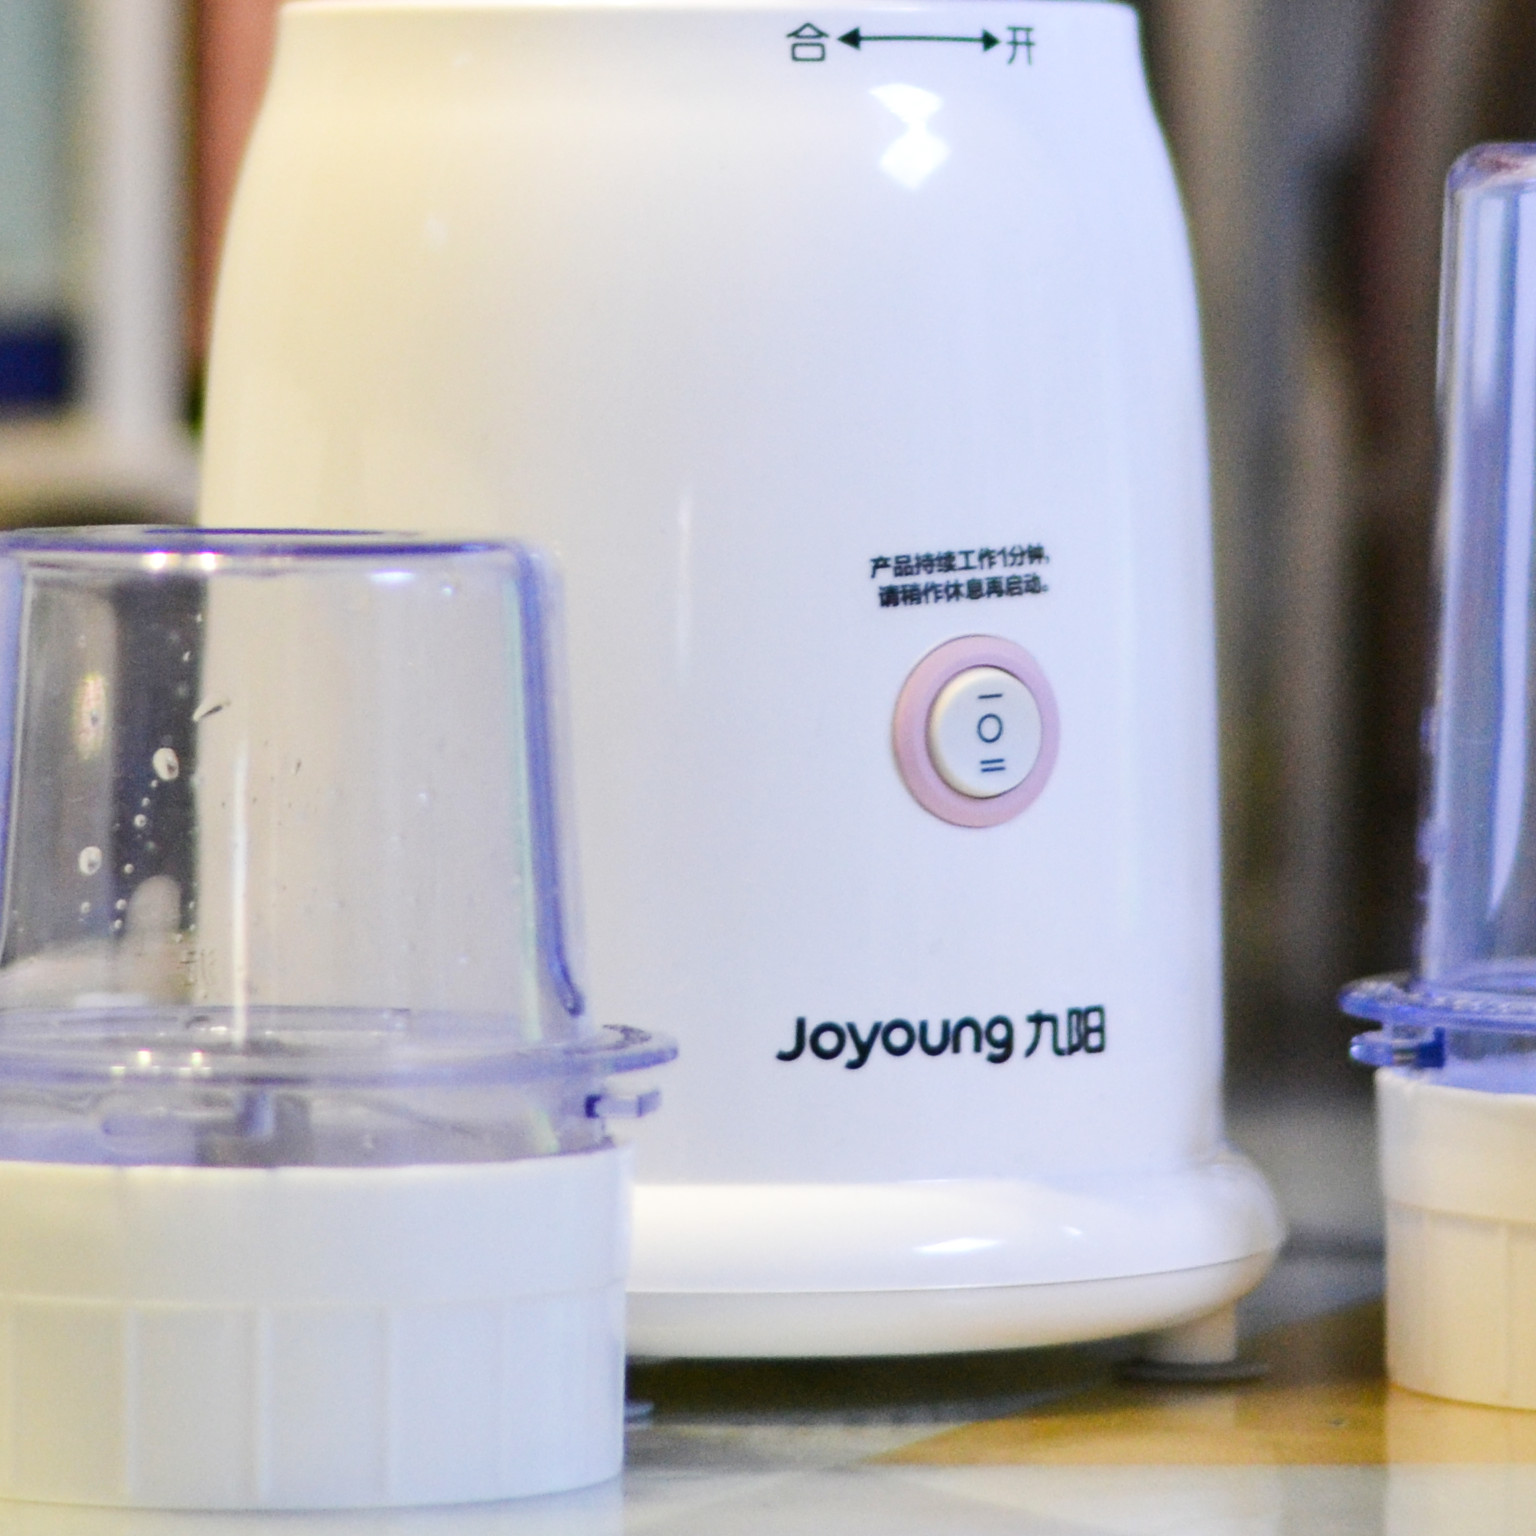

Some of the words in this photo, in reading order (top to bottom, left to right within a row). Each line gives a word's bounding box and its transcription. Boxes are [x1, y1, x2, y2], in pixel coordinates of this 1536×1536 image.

[786, 22, 830, 62] 合
[1005, 25, 1036, 65] 开
[775, 1015, 1015, 1070] Joyoung
[1024, 1004, 1107, 1059] 九阳
